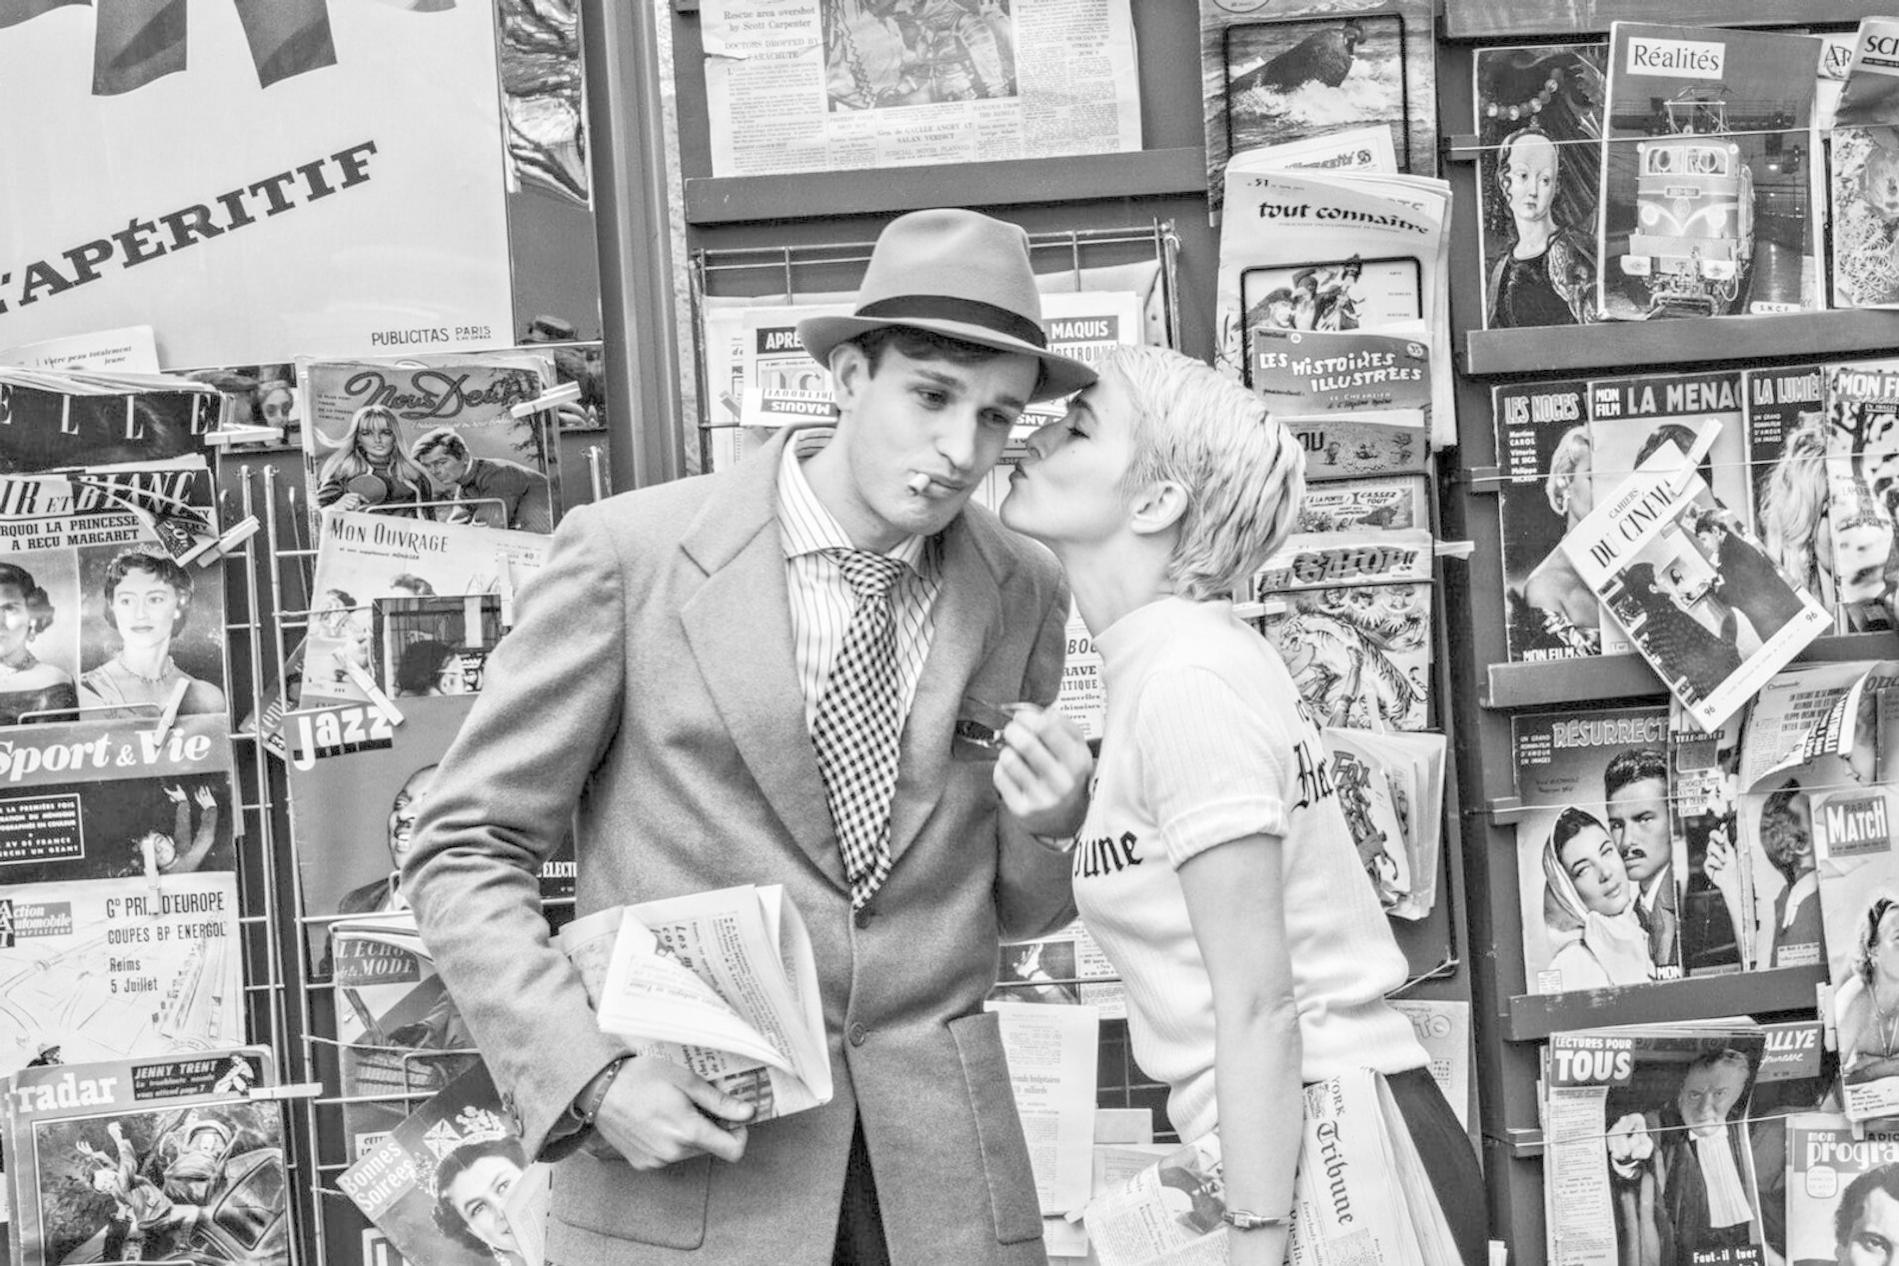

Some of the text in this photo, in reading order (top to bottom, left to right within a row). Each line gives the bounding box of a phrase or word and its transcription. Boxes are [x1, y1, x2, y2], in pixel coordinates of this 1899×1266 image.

[1634, 45, 1719, 71] Réalités
[0, 139, 378, 315] 'APÉRITIF
[1259, 201, 1310, 219] tout
[1315, 207, 1429, 234] connaître
[371, 327, 449, 346] PUBLICITAS
[456, 325, 491, 335] PARIS
[1051, 320, 1109, 340] MAQUIS
[1260, 352, 1288, 369] LES
[1596, 388, 1620, 403] MON
[1753, 379, 1774, 405] LA
[1838, 374, 1880, 397] MON
[771, 401, 830, 417] MAQUIS
[1505, 393, 1579, 424] LES NOCES
[1596, 404, 1620, 416] FILM
[1628, 387, 1655, 414] LA
[1509, 438, 1536, 447] CAROL
[75, 472, 195, 513] BLANC
[0, 515, 140, 537] RQUOI LA PRINCESSE
[12, 539, 20, 550] A
[67, 529, 140, 546] MARGARET
[1590, 536, 1619, 569] DU
[1805, 611, 1818, 623] 96
[1523, 647, 1575, 662] MON FILM
[1061, 680, 1098, 692] ITIQUE
[1704, 705, 1716, 716] 96
[0, 728, 212, 783] Sport & Vie
[1827, 800, 1887, 844] MATCH
[125, 891, 225, 916] PRI D'EUROPE
[108, 921, 227, 945] COUPES BP ENERGOL
[109, 956, 142, 973] Reims
[1657, 965, 1682, 979] MON
[111, 976, 158, 994] 5 Juillet
[1556, 1036, 1633, 1050] LECTURES POUR
[1763, 1028, 1819, 1051] ALLYE
[135, 1060, 218, 1080] JENNY TRENT
[1554, 1050, 1632, 1081] TOUS
[18, 1071, 118, 1113] radar
[1807, 1131, 1837, 1143] mon
[1807, 1142, 1899, 1171] progra
[339, 1141, 402, 1196] Bonnes
[1315, 1119, 1355, 1226] Tribune
[1693, 1248, 1730, 1264] Faut-il
